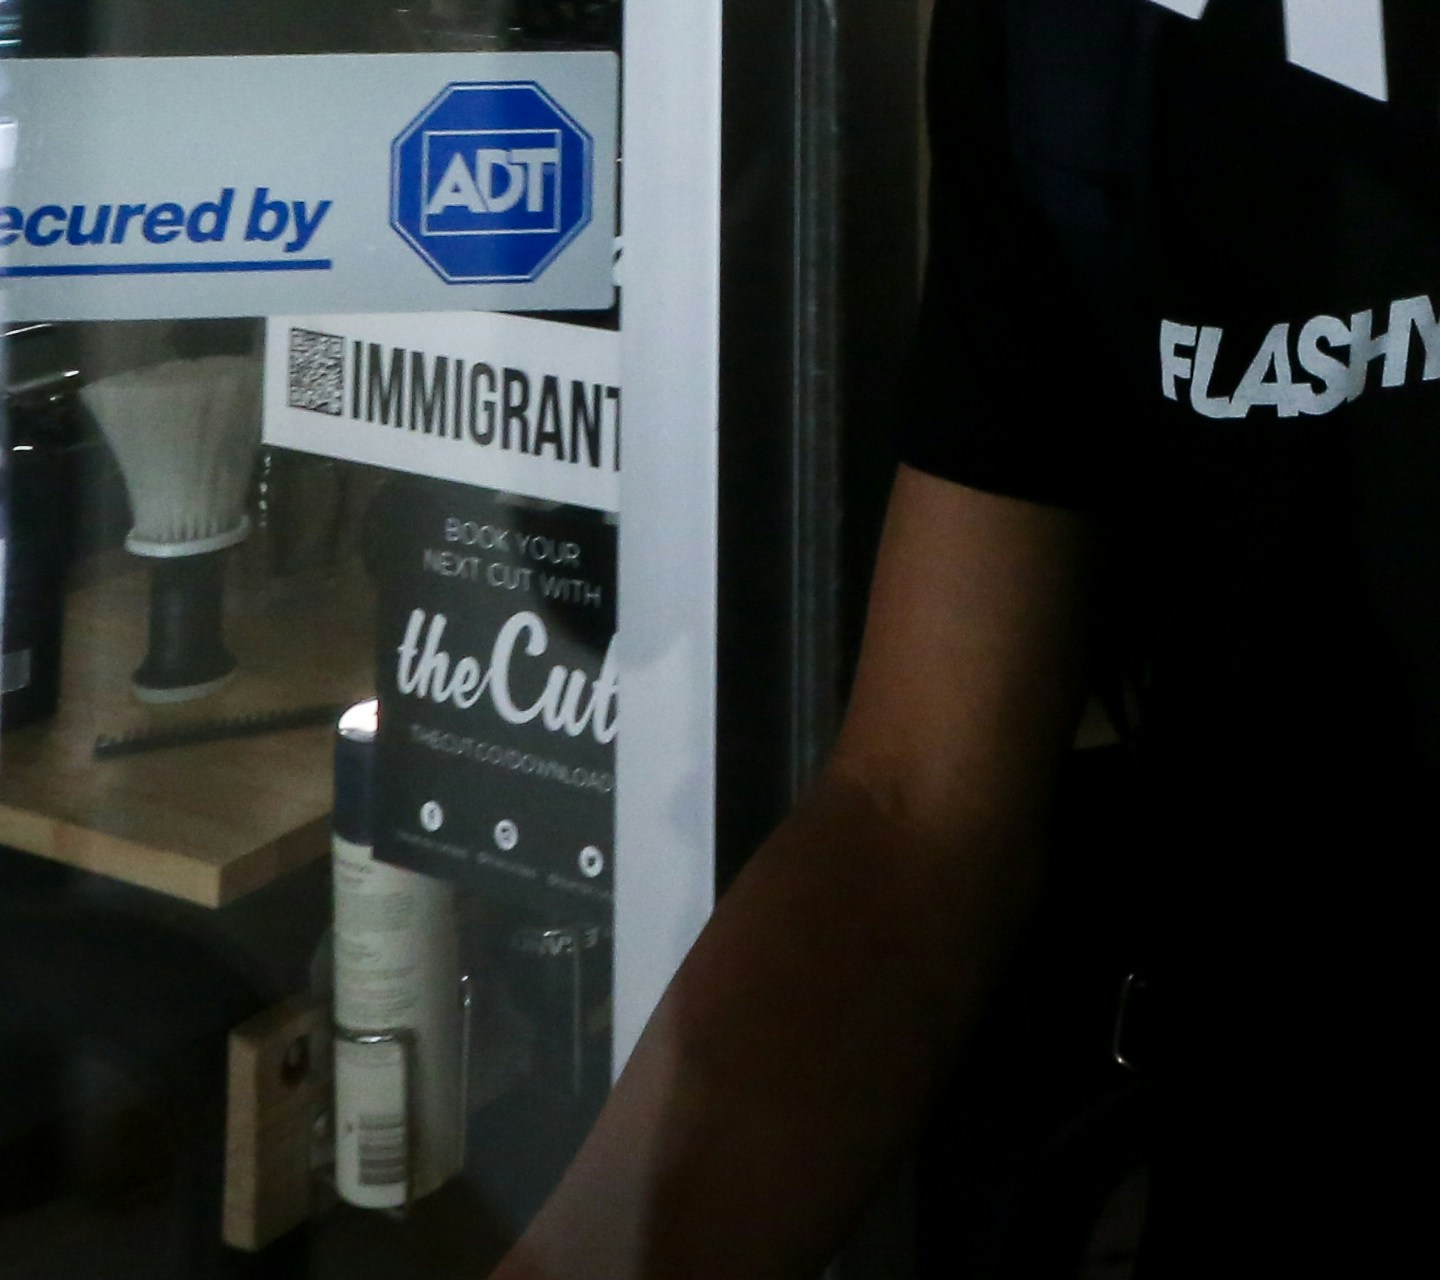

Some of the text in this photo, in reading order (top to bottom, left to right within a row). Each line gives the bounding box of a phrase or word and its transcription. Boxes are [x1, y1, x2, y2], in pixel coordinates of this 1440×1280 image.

[425, 145, 560, 217] ADT
[242, 187, 332, 254] by
[443, 516, 582, 569] BOOK YOUR
[422, 547, 603, 609] NEXT CUT WITH
